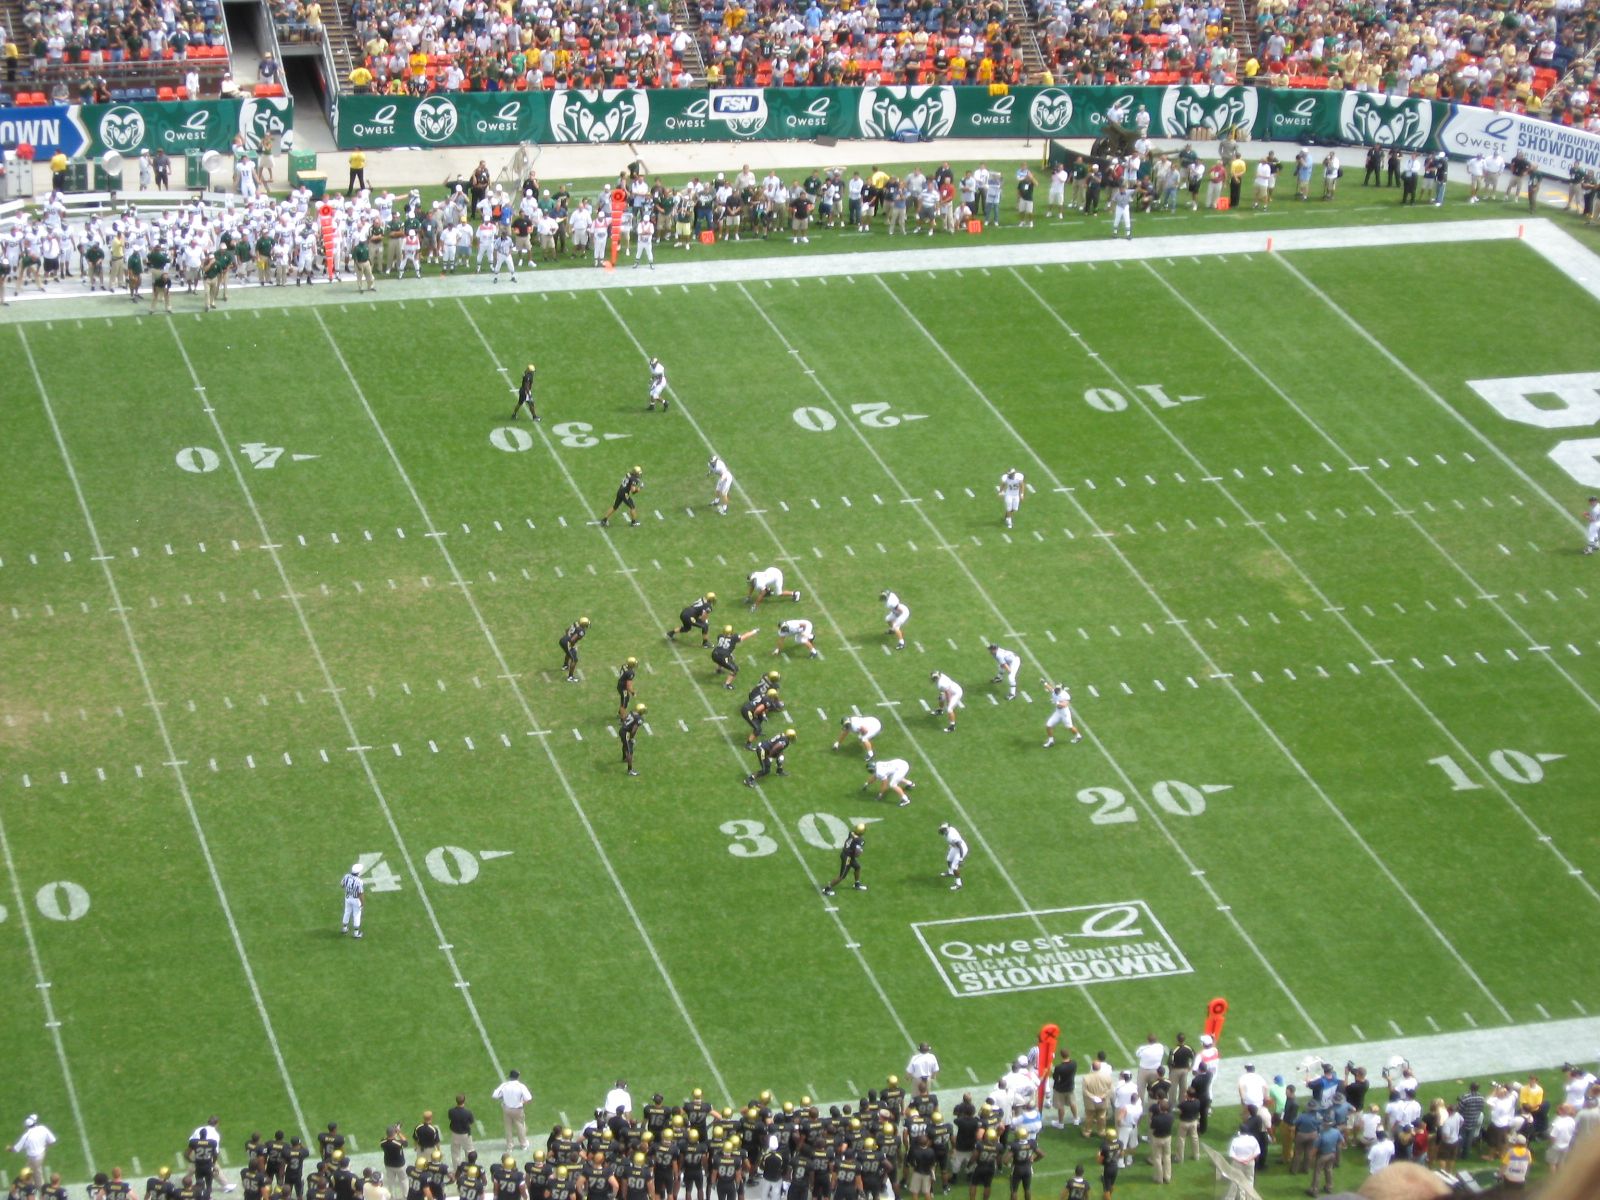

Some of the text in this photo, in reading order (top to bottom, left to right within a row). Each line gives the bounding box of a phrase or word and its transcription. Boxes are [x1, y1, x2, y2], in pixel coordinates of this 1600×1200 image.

[719, 96, 753, 112] FSN
[477, 120, 518, 133] Qwest
[665, 117, 706, 129] Qwest
[786, 115, 827, 127] Qwest
[971, 113, 1012, 125] Qwest
[1090, 112, 1130, 125] Qwt
[1274, 113, 1312, 126] Qwest
[164, 129, 207, 142] Qwest
[353, 123, 395, 137] Qwest
[1519, 122, 1554, 139] ROCKY
[1455, 132, 1508, 153] Qwest
[793, 402, 901, 431] 20
[489, 421, 600, 453] 30
[175, 442, 285, 473] 40
[1427, 749, 1544, 791] 10
[1076, 780, 1207, 825] 20
[719, 812, 850, 858] 30
[358, 845, 480, 893] 40
[939, 934, 1070, 961] Qwest
[952, 941, 1164, 974] ROCKY MOUNTAIN
[957, 953, 1178, 992] SHOWDOWN
[195, 1147, 213, 1160] 25
[500, 1181, 517, 1193] 79
